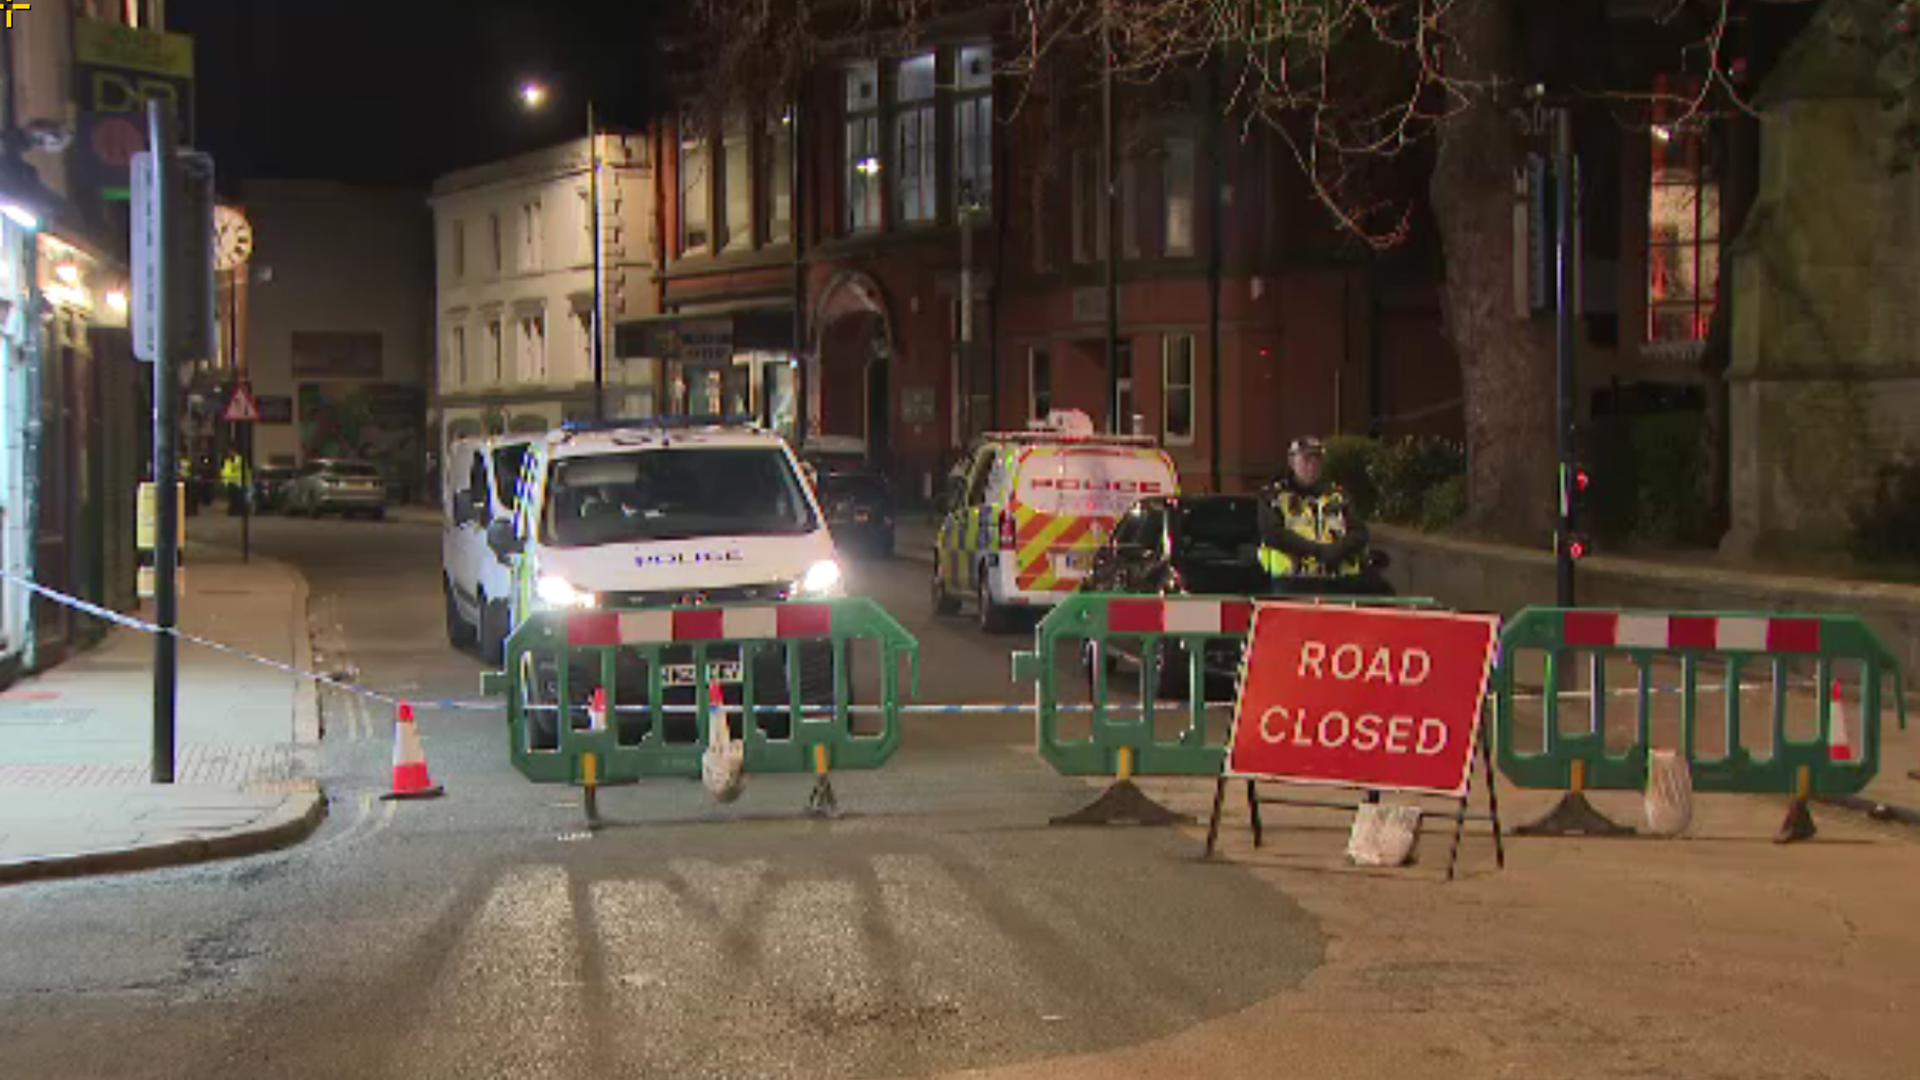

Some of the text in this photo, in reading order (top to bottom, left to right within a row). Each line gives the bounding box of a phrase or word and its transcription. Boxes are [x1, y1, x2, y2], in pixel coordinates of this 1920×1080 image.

[1032, 478, 1161, 493] POLICE
[634, 550, 744, 567] POLICE
[1298, 640, 1431, 685] ROAD
[1259, 705, 1448, 754] CLOSED
